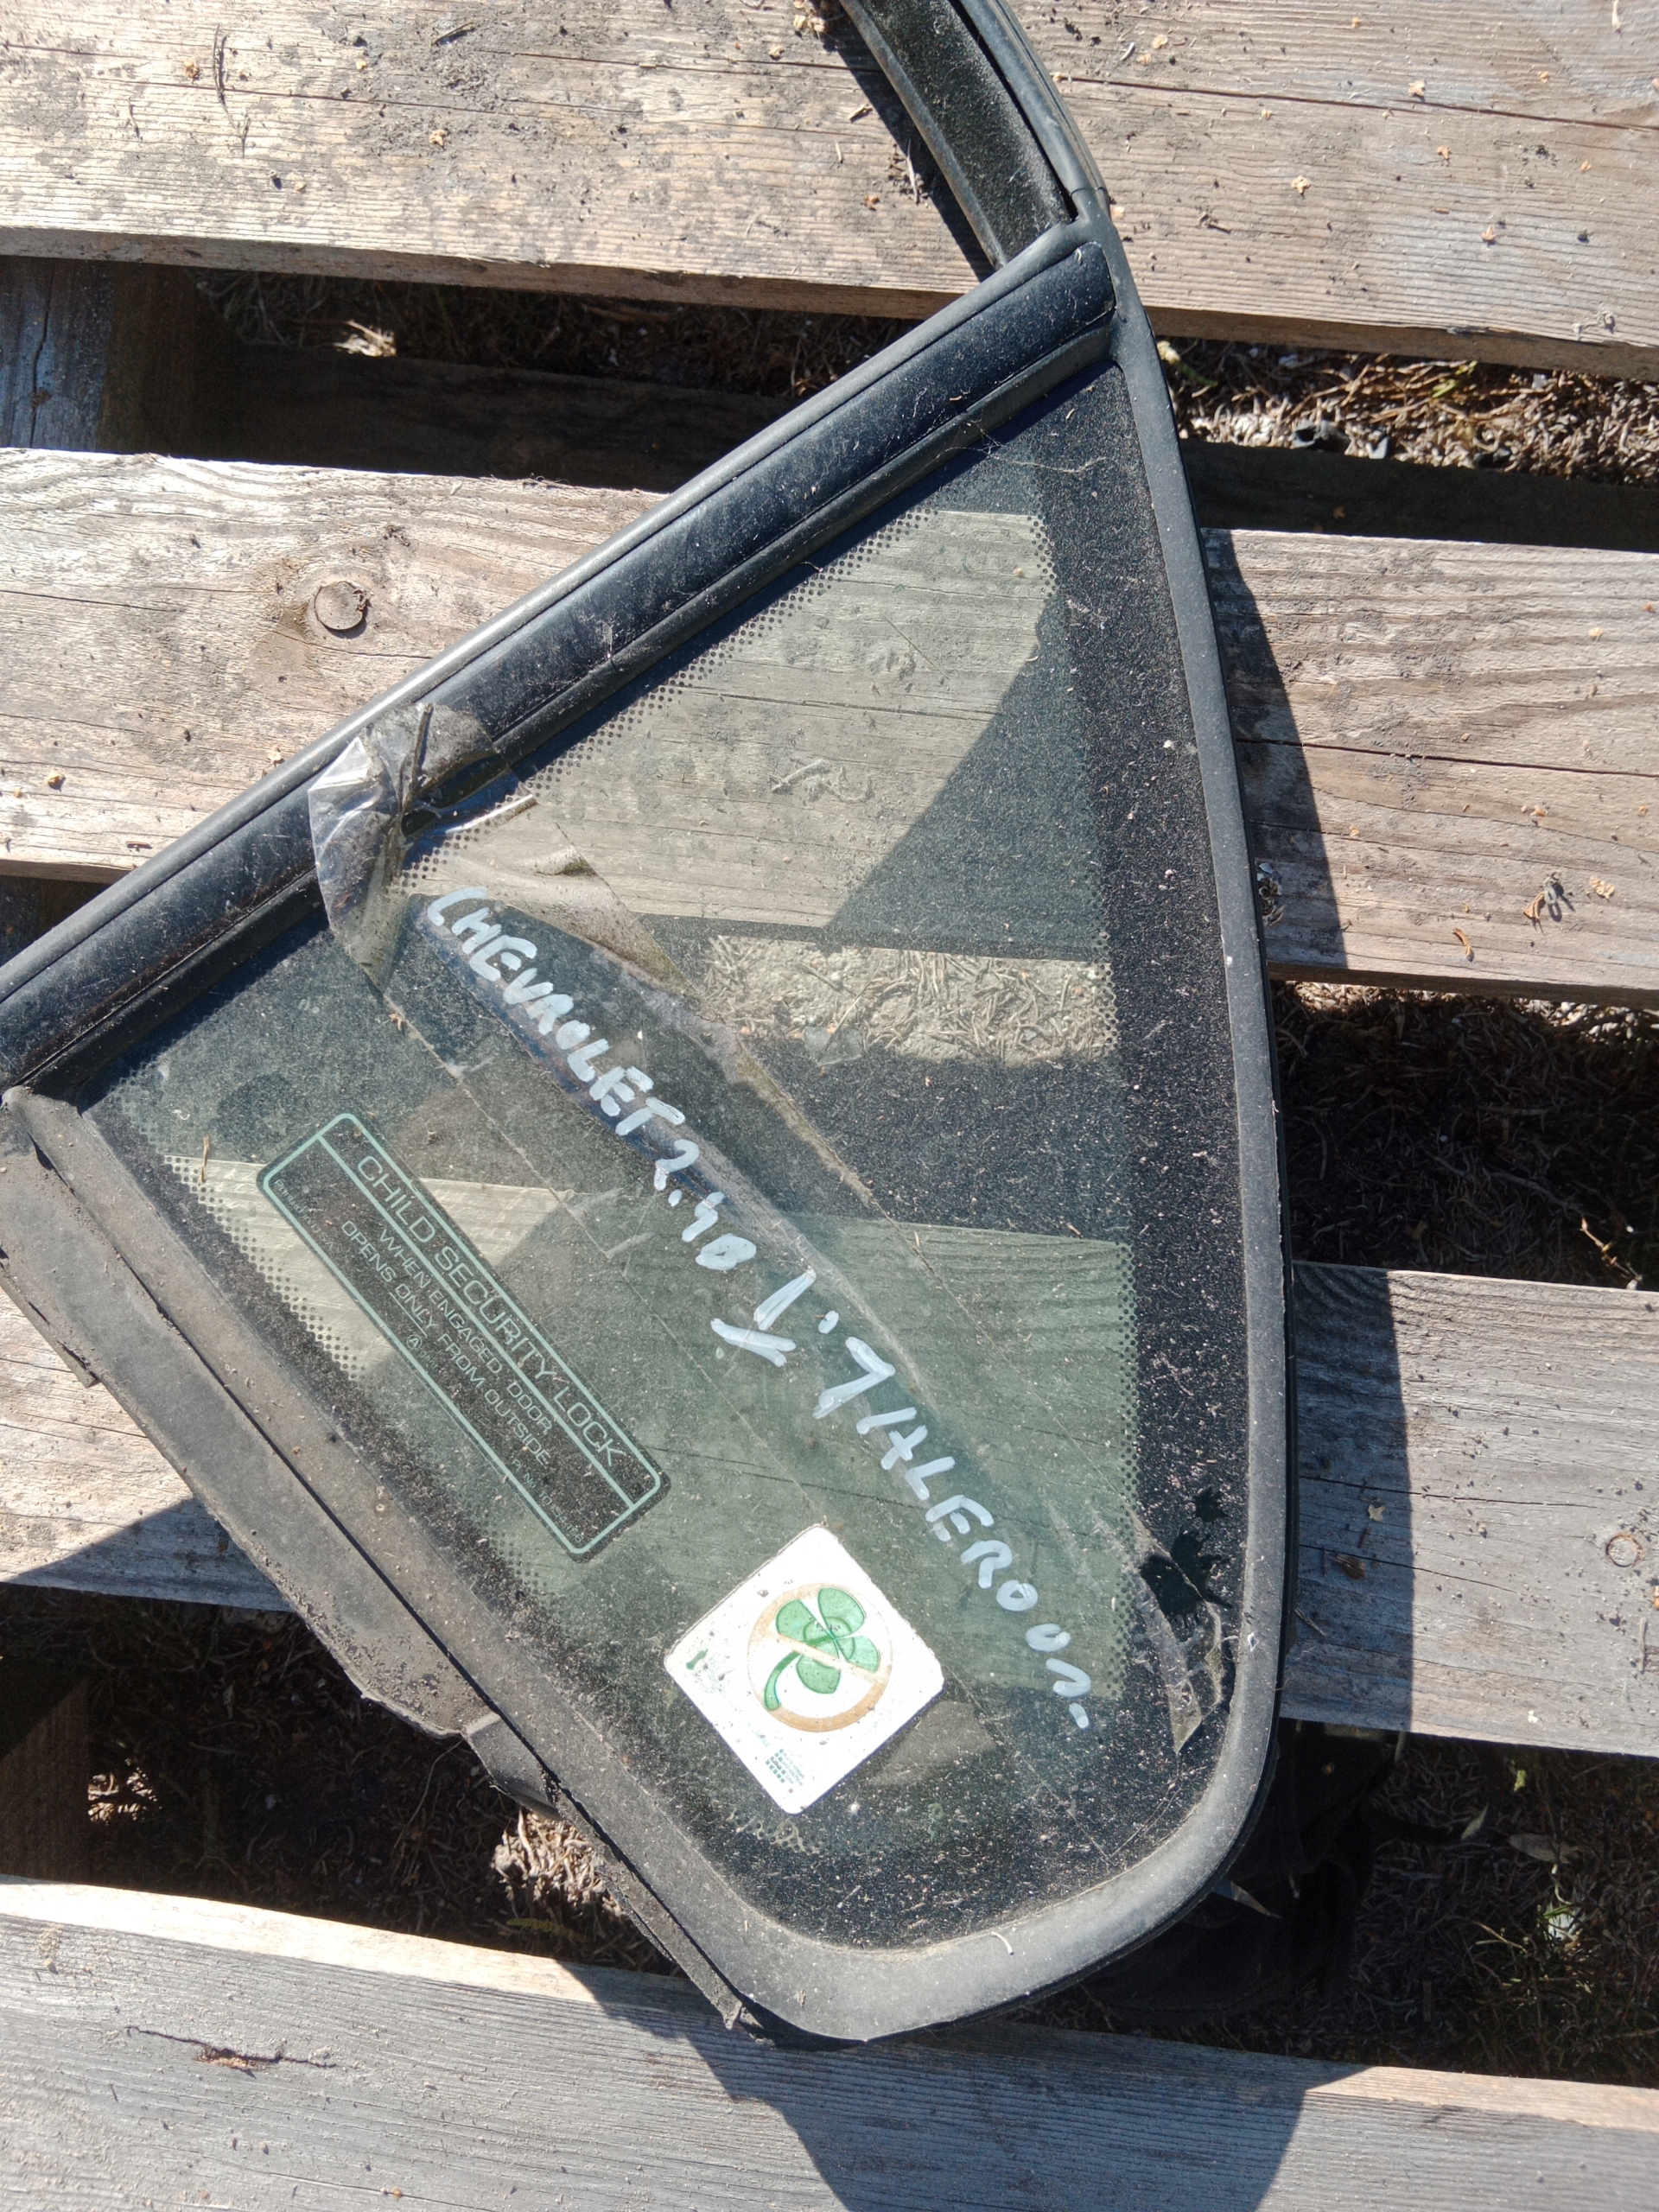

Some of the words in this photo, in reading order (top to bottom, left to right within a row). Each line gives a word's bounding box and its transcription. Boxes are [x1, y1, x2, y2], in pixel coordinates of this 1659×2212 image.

[427, 887, 685, 1137] CHEVROLET
[340, 1217, 397, 1284] OPENS
[393, 1281, 439, 1333] ONLY
[435, 1332, 486, 1389] FROM
[354, 1152, 438, 1246] CHILD
[432, 1243, 557, 1386] SECURITY
[551, 1384, 625, 1467] LOCK
[377, 1227, 431, 1290] WHEN
